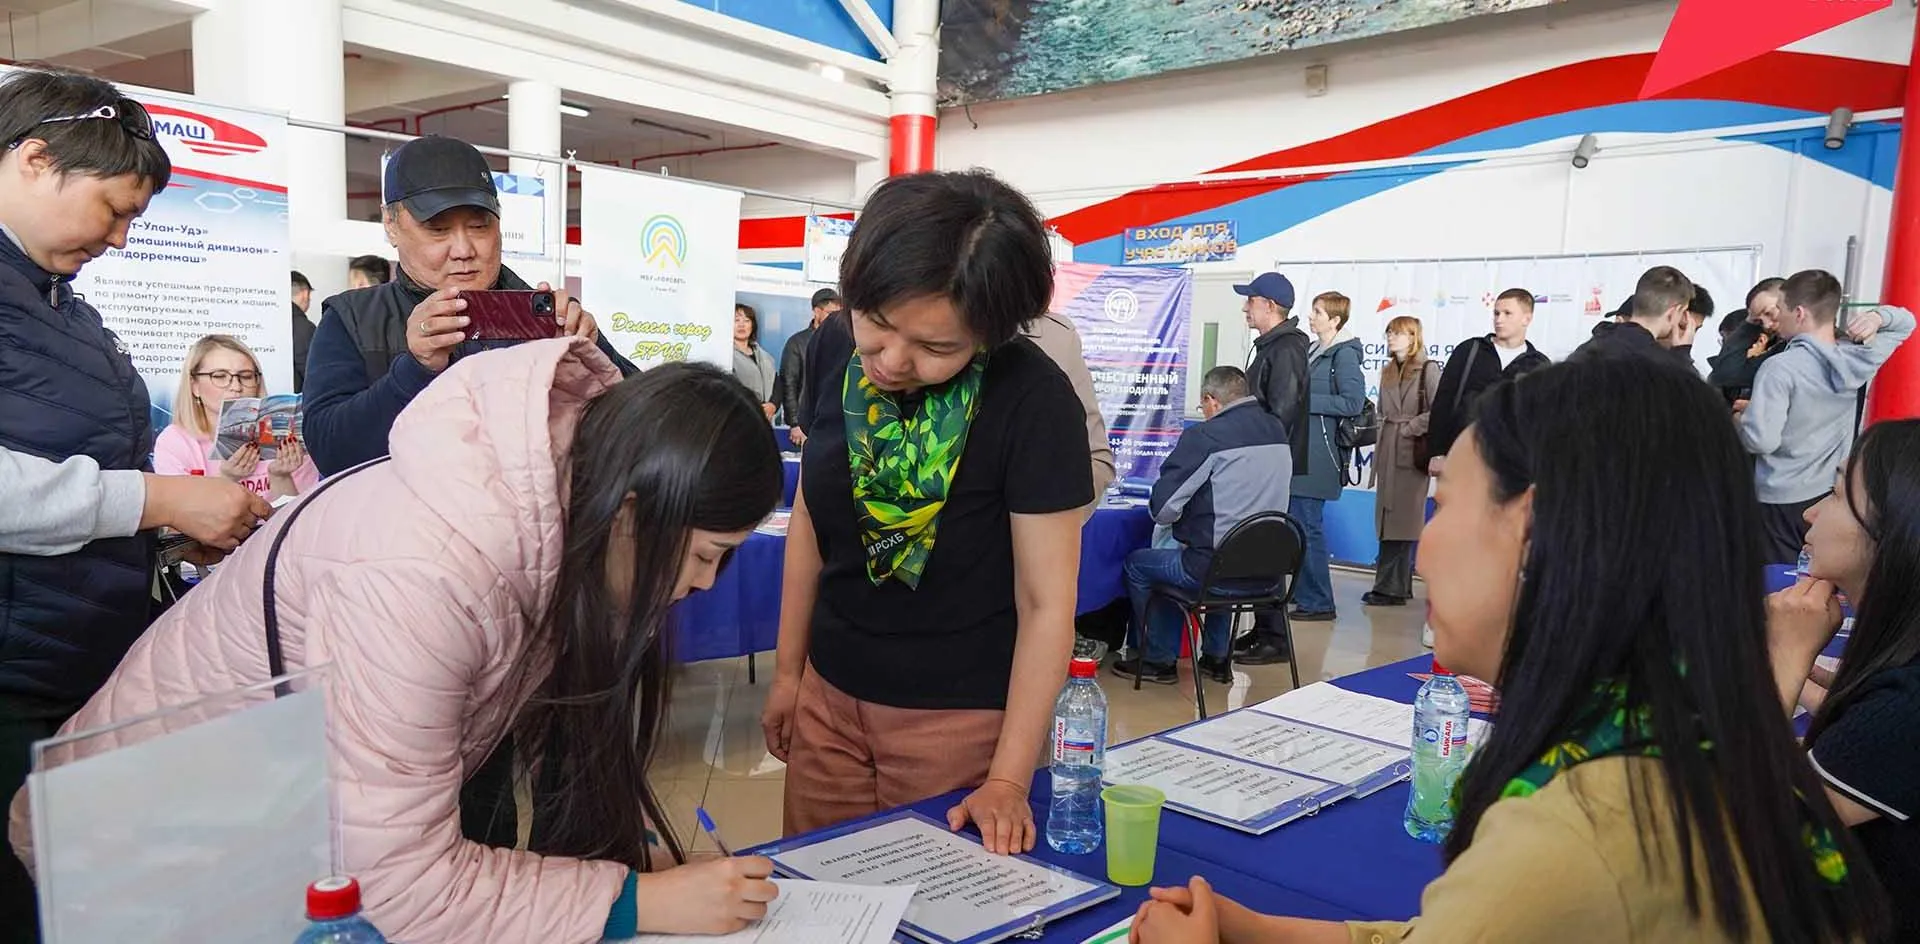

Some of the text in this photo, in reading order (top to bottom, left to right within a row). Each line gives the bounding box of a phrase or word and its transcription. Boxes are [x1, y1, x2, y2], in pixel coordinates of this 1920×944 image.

[1135, 222, 1228, 241] ВХОД ДЛЯ
[207, 242, 270, 255] дивизион»
[1125, 239, 1238, 260] УЧАСТНИКОВ
[94, 276, 277, 296] Является успешным предприятием
[112, 292, 159, 302] ремонту
[162, 294, 239, 306] электрических
[96, 303, 193, 316] эксплуатируемых
[104, 315, 201, 328] елезнодорожном
[612, 312, 712, 342] Делаем город
[142, 341, 186, 351] деталей
[875, 532, 904, 553] РСХБ
